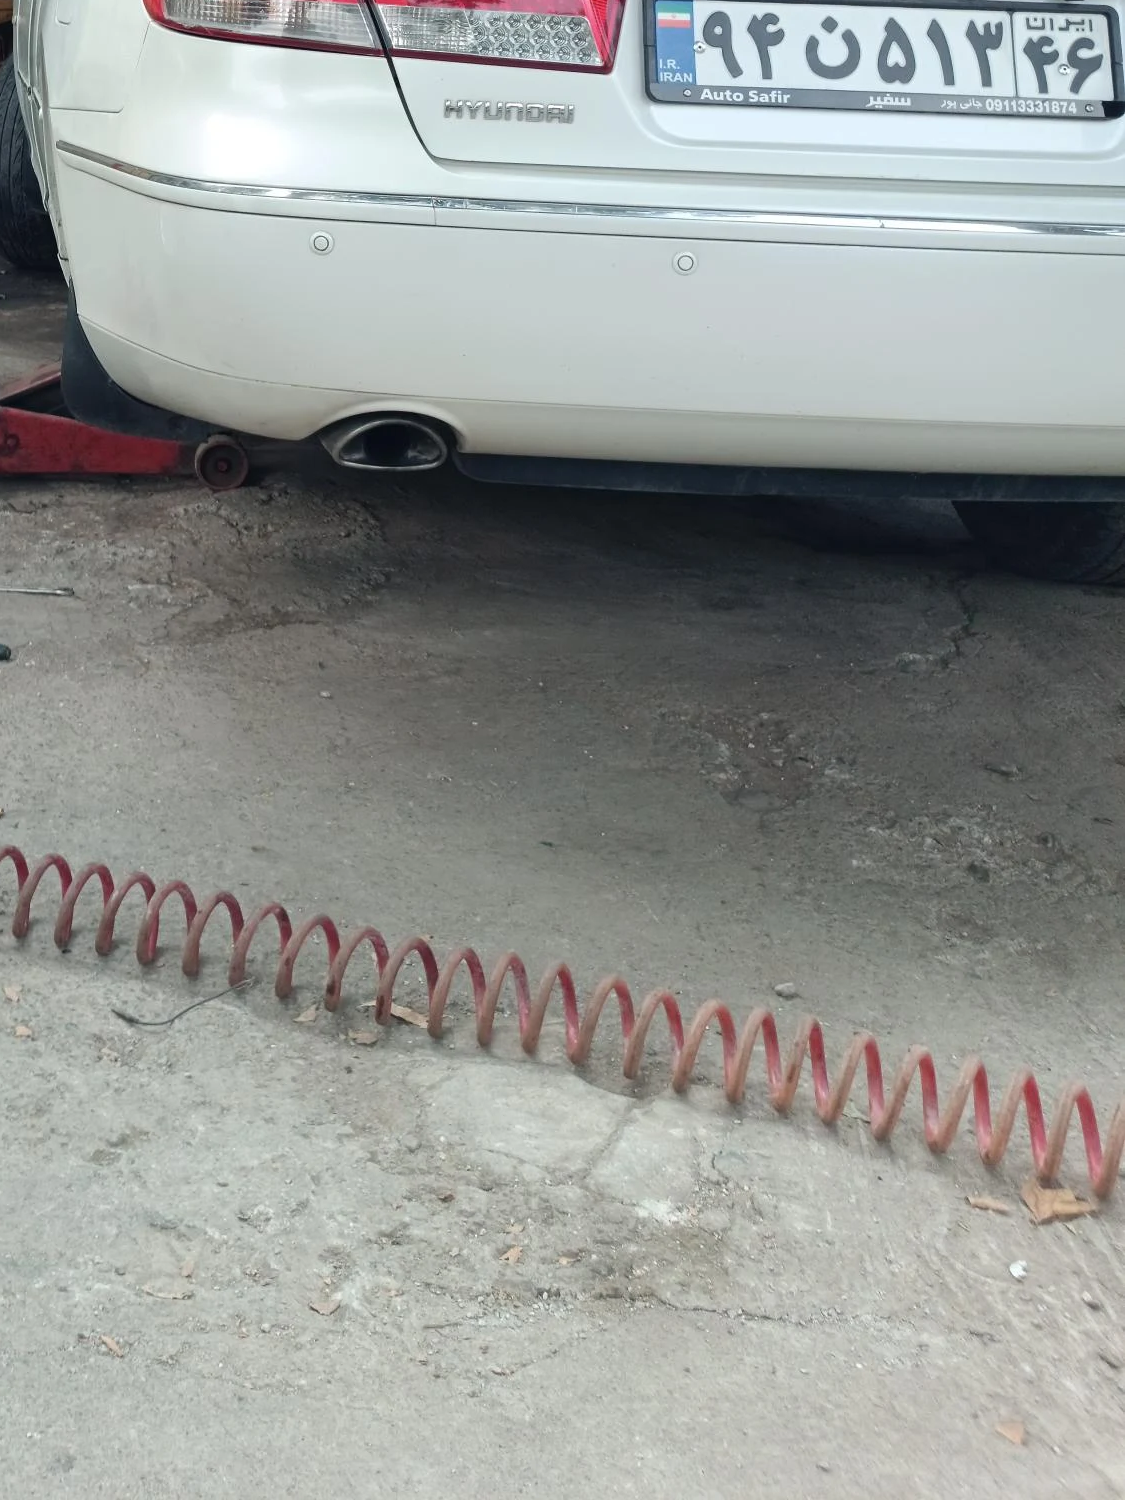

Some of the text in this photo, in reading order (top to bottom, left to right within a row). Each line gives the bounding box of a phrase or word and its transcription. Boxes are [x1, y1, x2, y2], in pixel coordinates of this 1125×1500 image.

[1025, 15, 1094, 32] ایران
[703, 11, 785, 80] ۹۴
[877, 17, 1004, 88] ۵۱۳
[659, 59, 680, 70] I.R.
[1023, 36, 1104, 95] ۴۶
[659, 72, 694, 83] IRAN
[700, 88, 790, 104] Auto Safir
[865, 94, 911, 108] سفیر
[443, 99, 575, 125] HYUNDAI
[985, 98, 1077, 114] 09113331874
